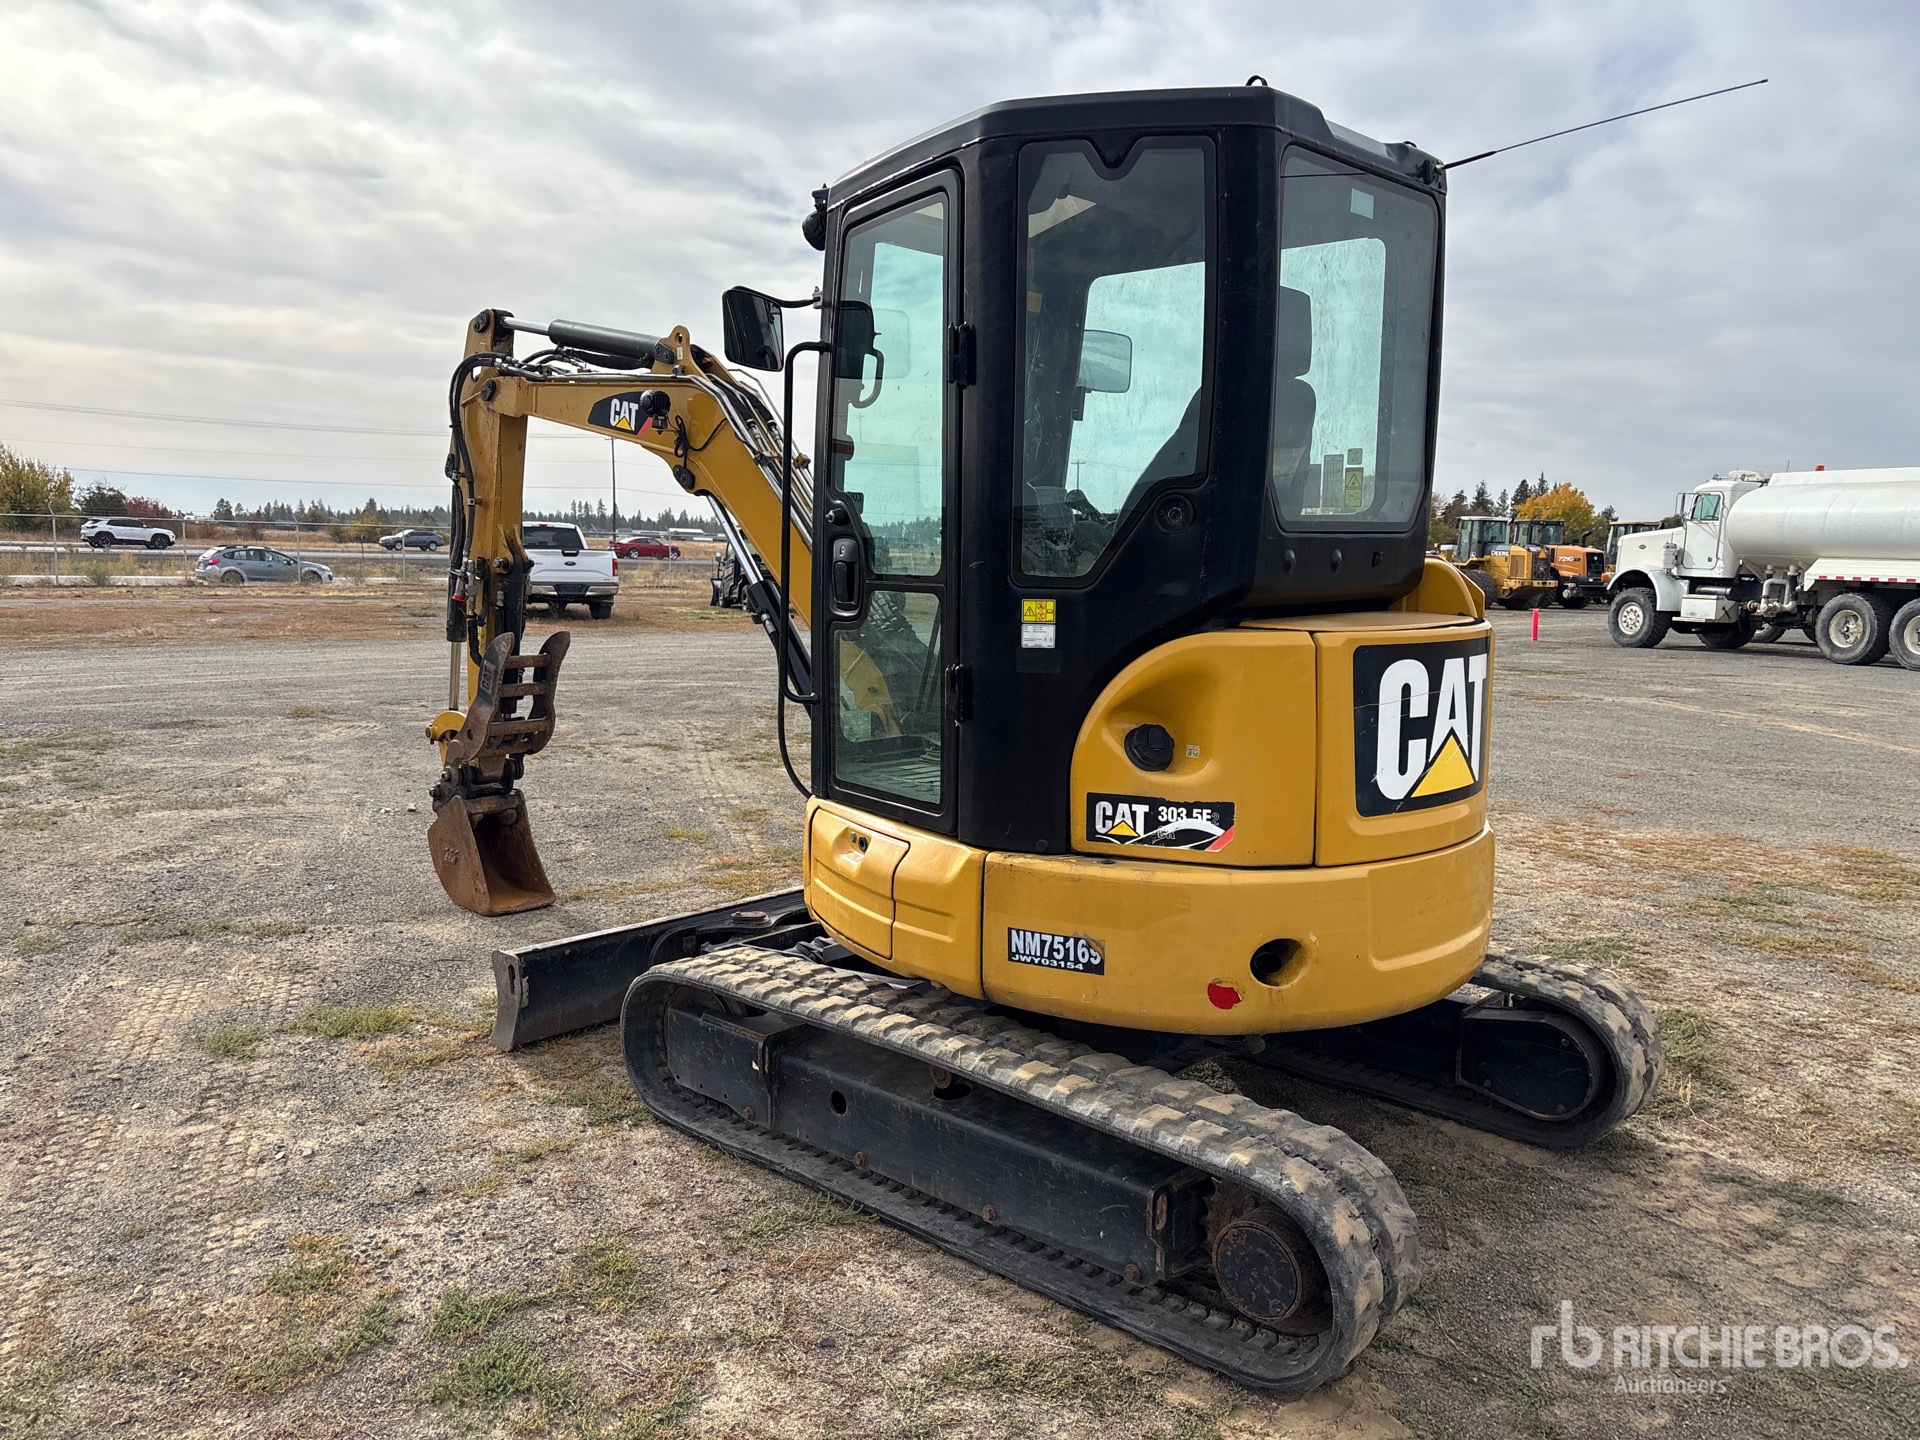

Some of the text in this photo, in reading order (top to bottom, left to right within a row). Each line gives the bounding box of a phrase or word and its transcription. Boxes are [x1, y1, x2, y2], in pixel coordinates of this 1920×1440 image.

[609, 398, 639, 431] CAT
[1376, 653, 1488, 801] CAT
[1095, 800, 1150, 837] CAT
[1011, 953, 1085, 971] JWY03154
